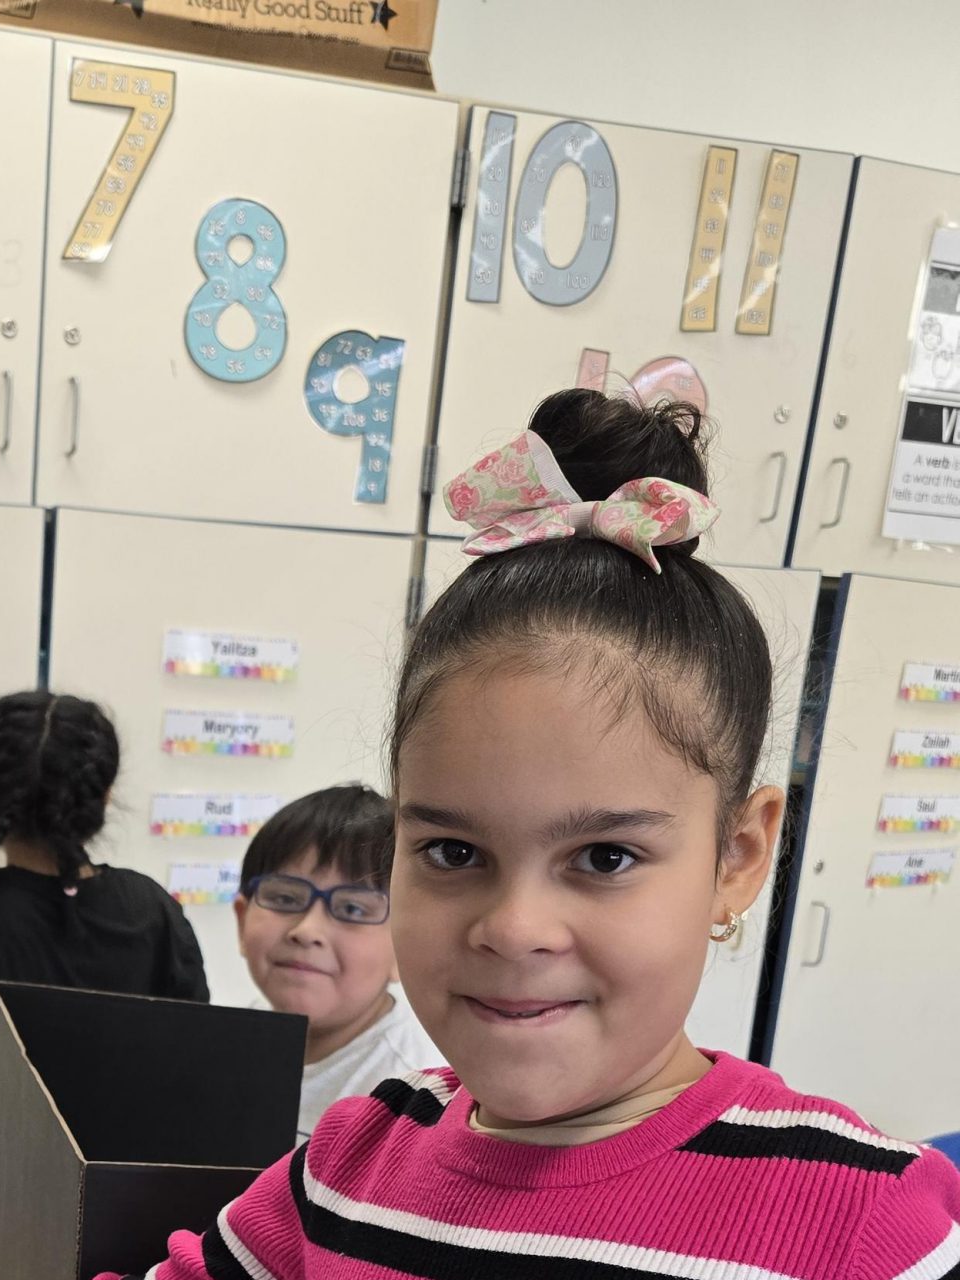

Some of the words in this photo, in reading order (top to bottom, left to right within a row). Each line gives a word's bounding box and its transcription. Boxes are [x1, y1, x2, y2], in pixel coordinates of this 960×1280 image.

[254, 0, 311, 20] Good
[314, 2, 367, 25] Stuff
[61, 56, 177, 264] 7
[466, 110, 620, 307] 10
[679, 145, 801, 335] 11
[183, 197, 288, 384] 8
[304, 329, 406, 505] 9
[926, 456, 951, 470] verb
[913, 474, 941, 486] word
[203, 720, 259, 738] Maryory
[205, 801, 234, 816] Rud
